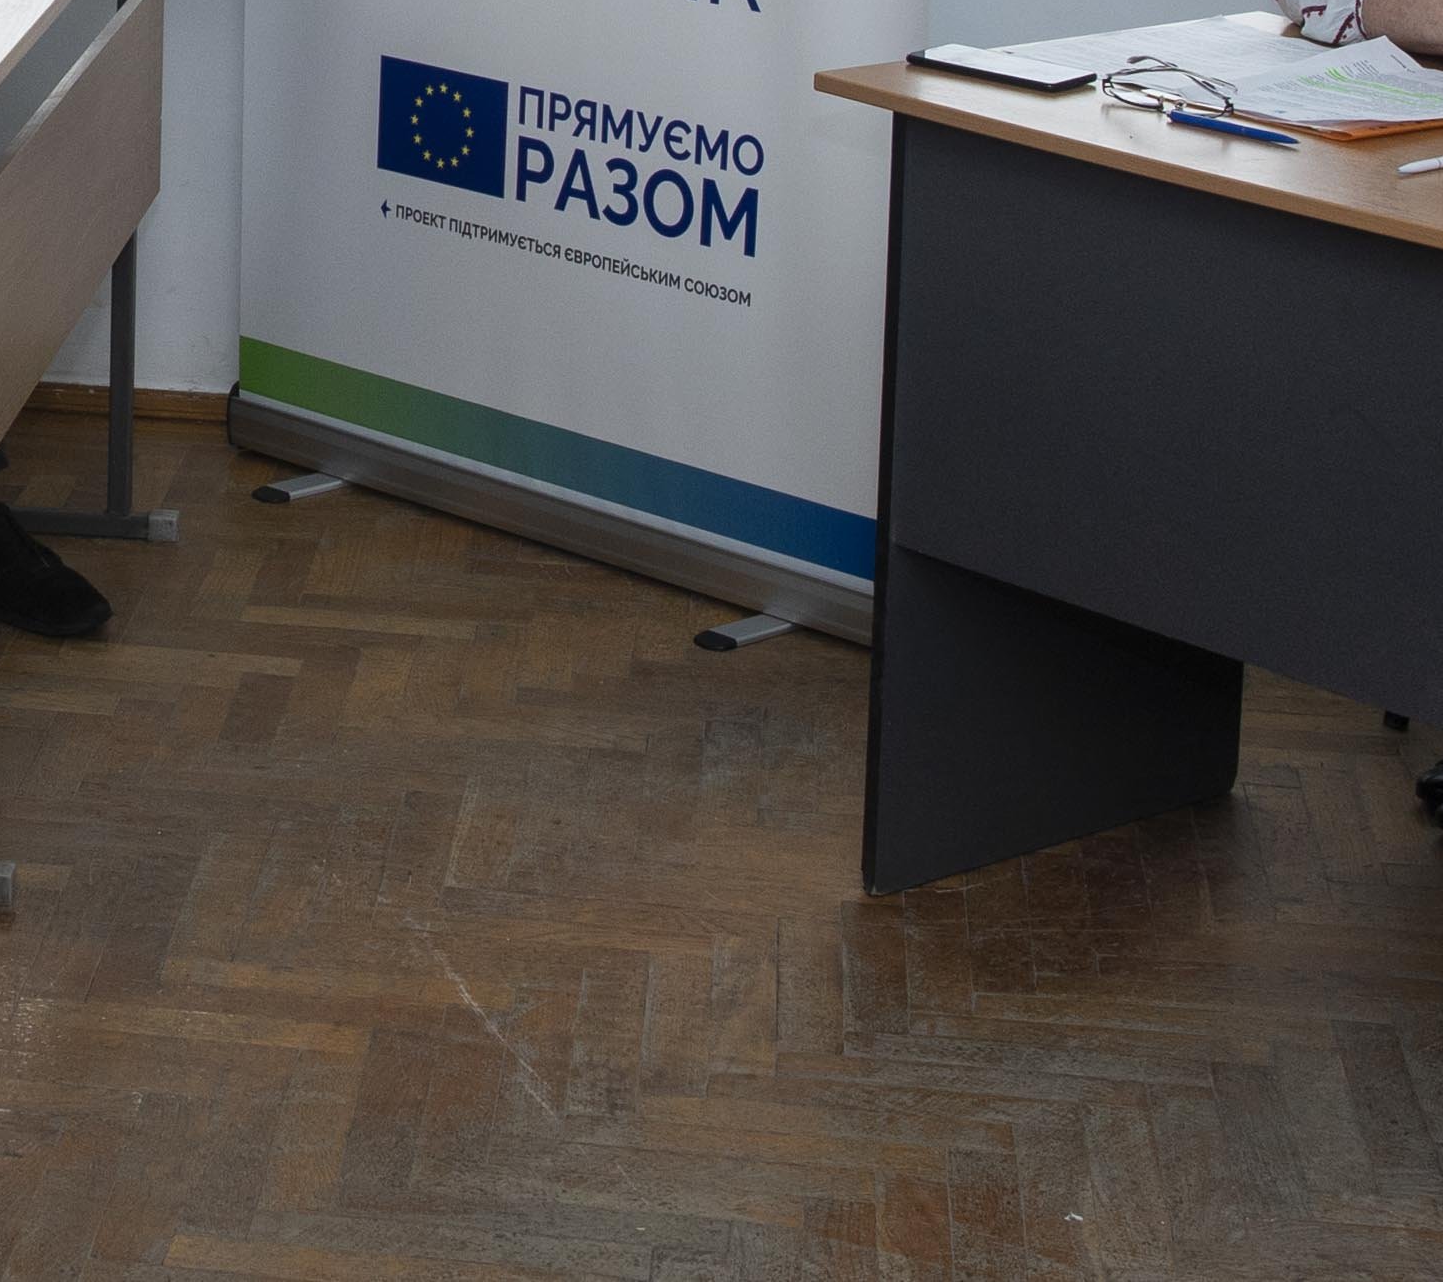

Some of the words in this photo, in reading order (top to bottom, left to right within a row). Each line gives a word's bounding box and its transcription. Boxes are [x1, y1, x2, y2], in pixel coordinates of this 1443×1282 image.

[518, 86, 765, 178] ПРЯМУЄМО
[516, 137, 760, 259] РАЗОМ
[395, 204, 446, 230] ПРОЕКТ
[448, 218, 561, 259] ПІДТРИМУЄТЬСЯ
[564, 247, 681, 291] ЄВРОПЕЙСЬКИМ
[684, 278, 752, 308] СОЮЗОМ
